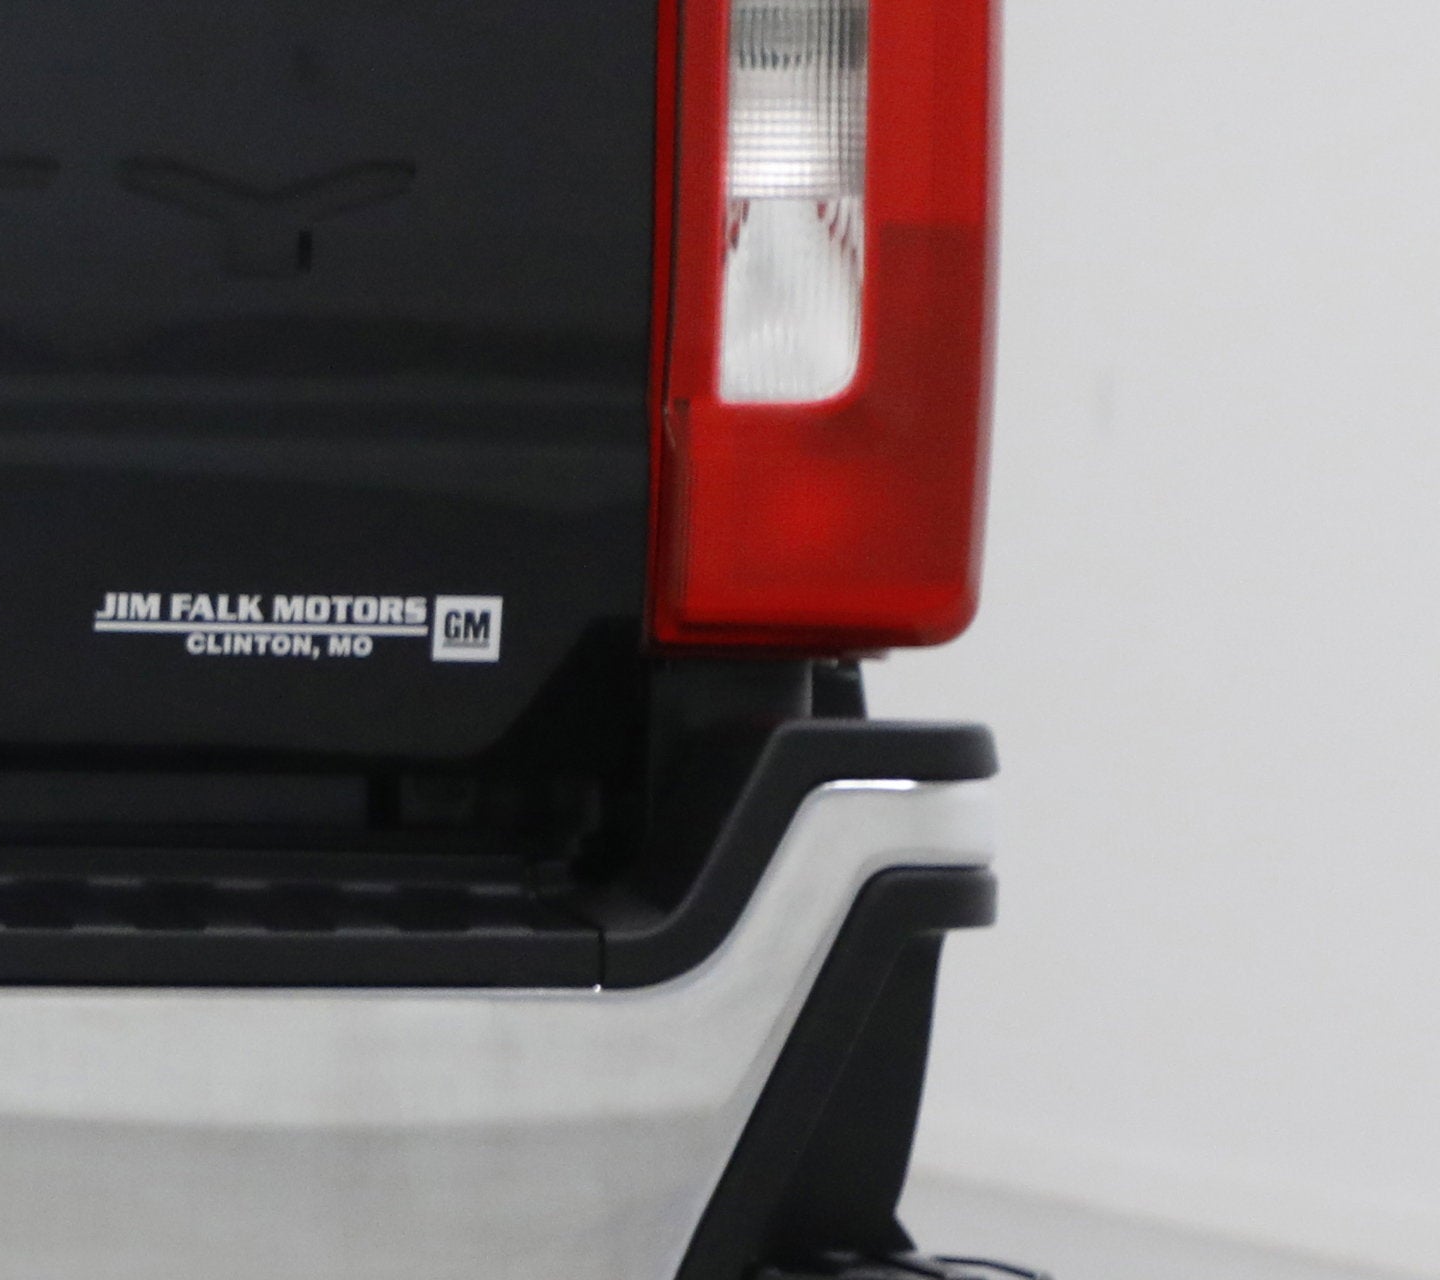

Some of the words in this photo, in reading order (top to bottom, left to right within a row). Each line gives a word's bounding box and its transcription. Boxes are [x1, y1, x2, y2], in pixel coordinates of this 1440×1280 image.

[94, 591, 161, 621] JIM
[168, 592, 263, 622] FALK
[272, 594, 428, 625] MOTORS
[443, 608, 491, 640] GM
[185, 632, 320, 660] CLINTON,
[327, 634, 374, 658] MO
